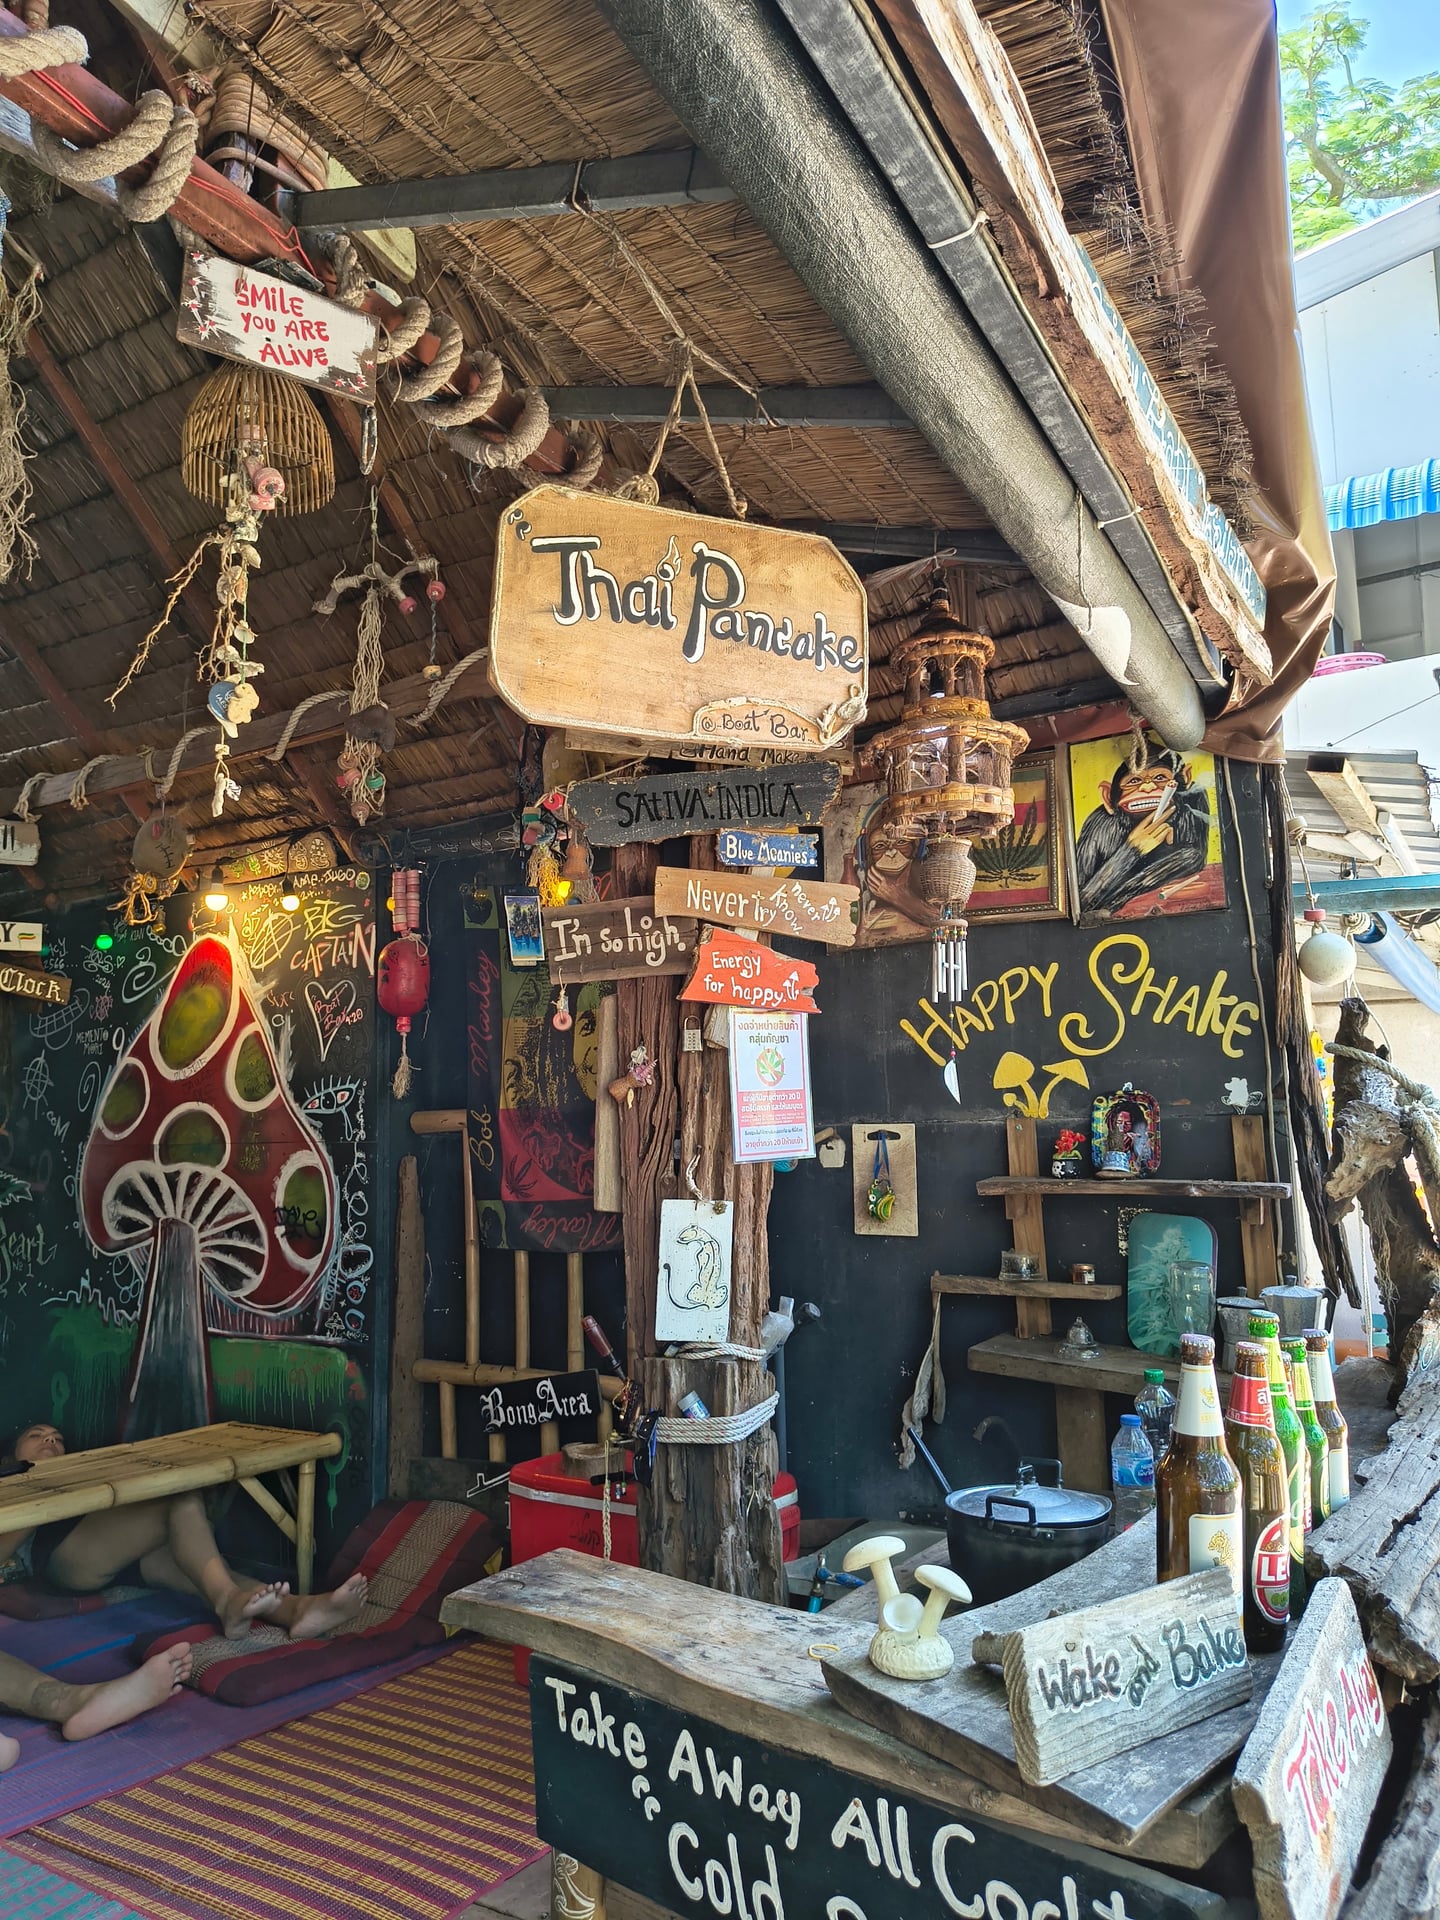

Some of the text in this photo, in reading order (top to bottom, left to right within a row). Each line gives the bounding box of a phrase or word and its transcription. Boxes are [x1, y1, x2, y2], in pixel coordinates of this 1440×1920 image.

[241, 312, 330, 342] YOU ARE
[530, 535, 865, 673] Thai Pancake
[726, 835, 753, 860] Blue
[687, 879, 750, 918] Never
[704, 974, 724, 993] for
[712, 952, 761, 978] Energy
[467, 950, 500, 1077] Marley
[900, 962, 1060, 1067] HAPPY
[480, 1377, 592, 1432] Bong Area
[1260, 1555, 1290, 1582] LE
[1037, 1614, 1246, 1712] Wake and Bake
[545, 1677, 648, 1770] Take
[831, 1797, 922, 1888] All
